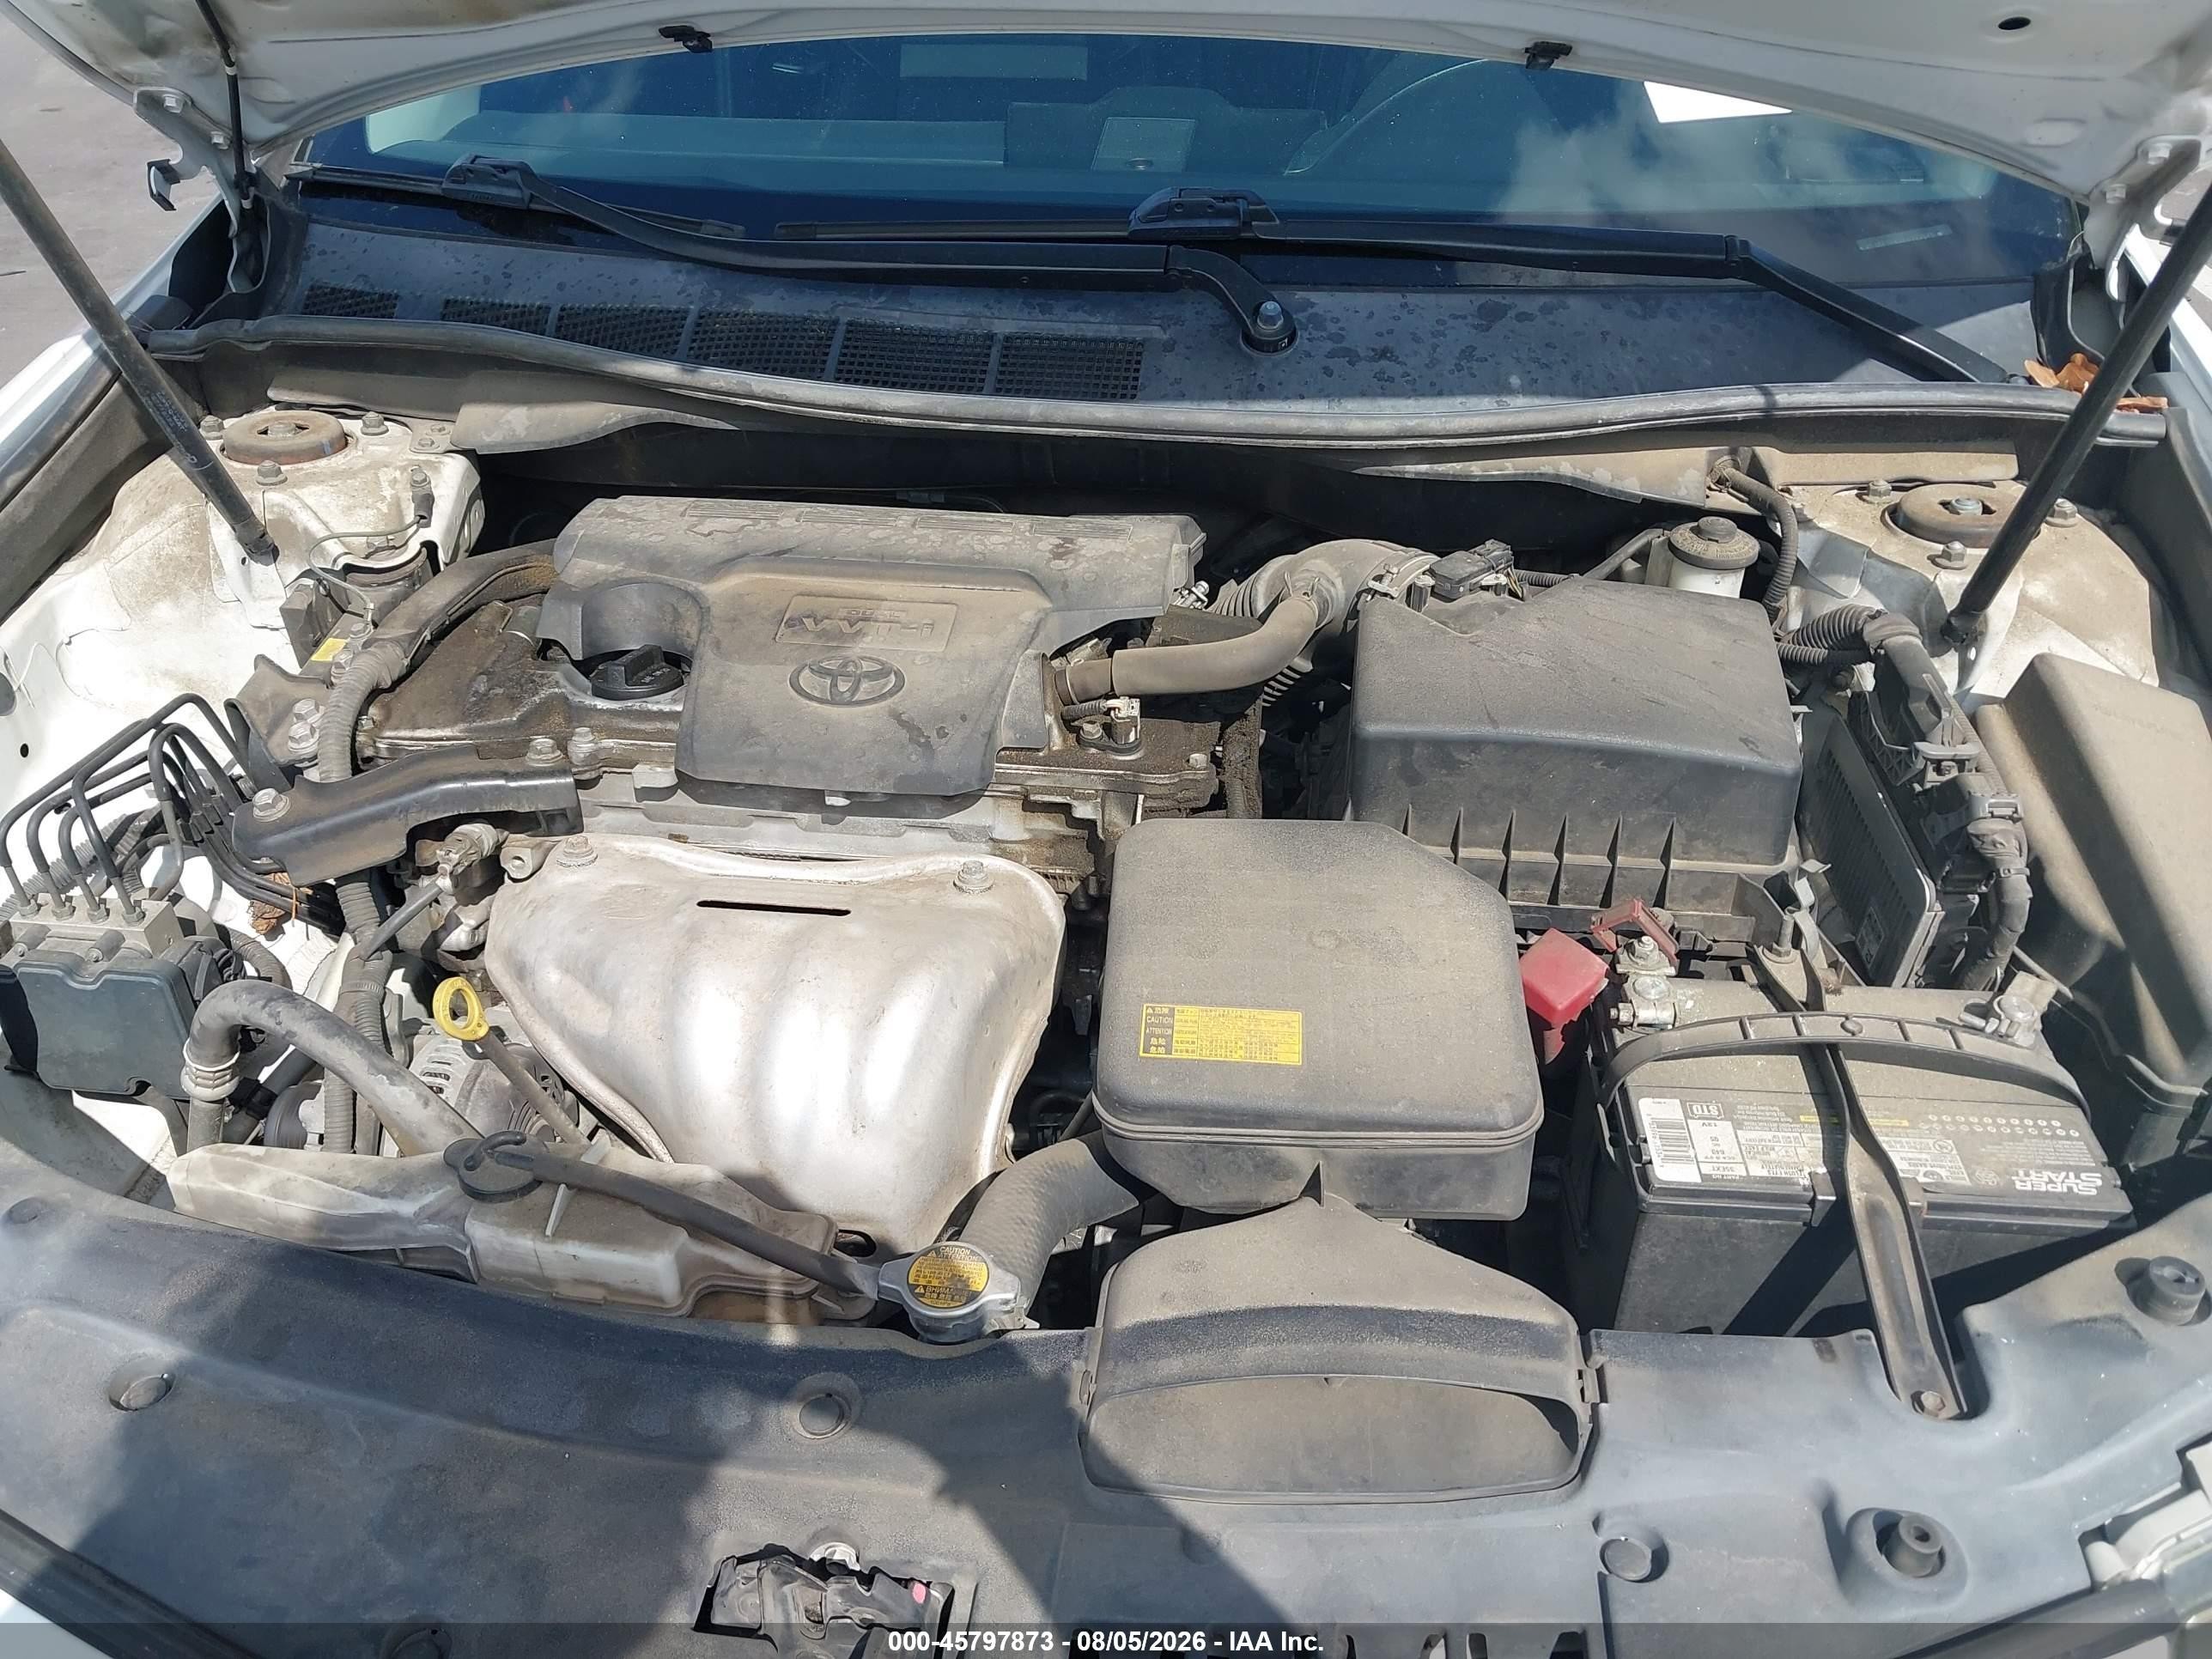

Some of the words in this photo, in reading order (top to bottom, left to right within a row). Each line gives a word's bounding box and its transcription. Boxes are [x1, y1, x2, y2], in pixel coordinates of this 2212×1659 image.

[1146, 1016, 1174, 1024] CAUTION
[1146, 1027, 1173, 1036] ATTENTION
[1692, 1104, 1719, 1115] STD
[2011, 1170, 2103, 1187] START
[2014, 1179, 2098, 1196] SUPER
[939, 1246, 970, 1255] CAUTION
[939, 1253, 980, 1261] ATTENTION
